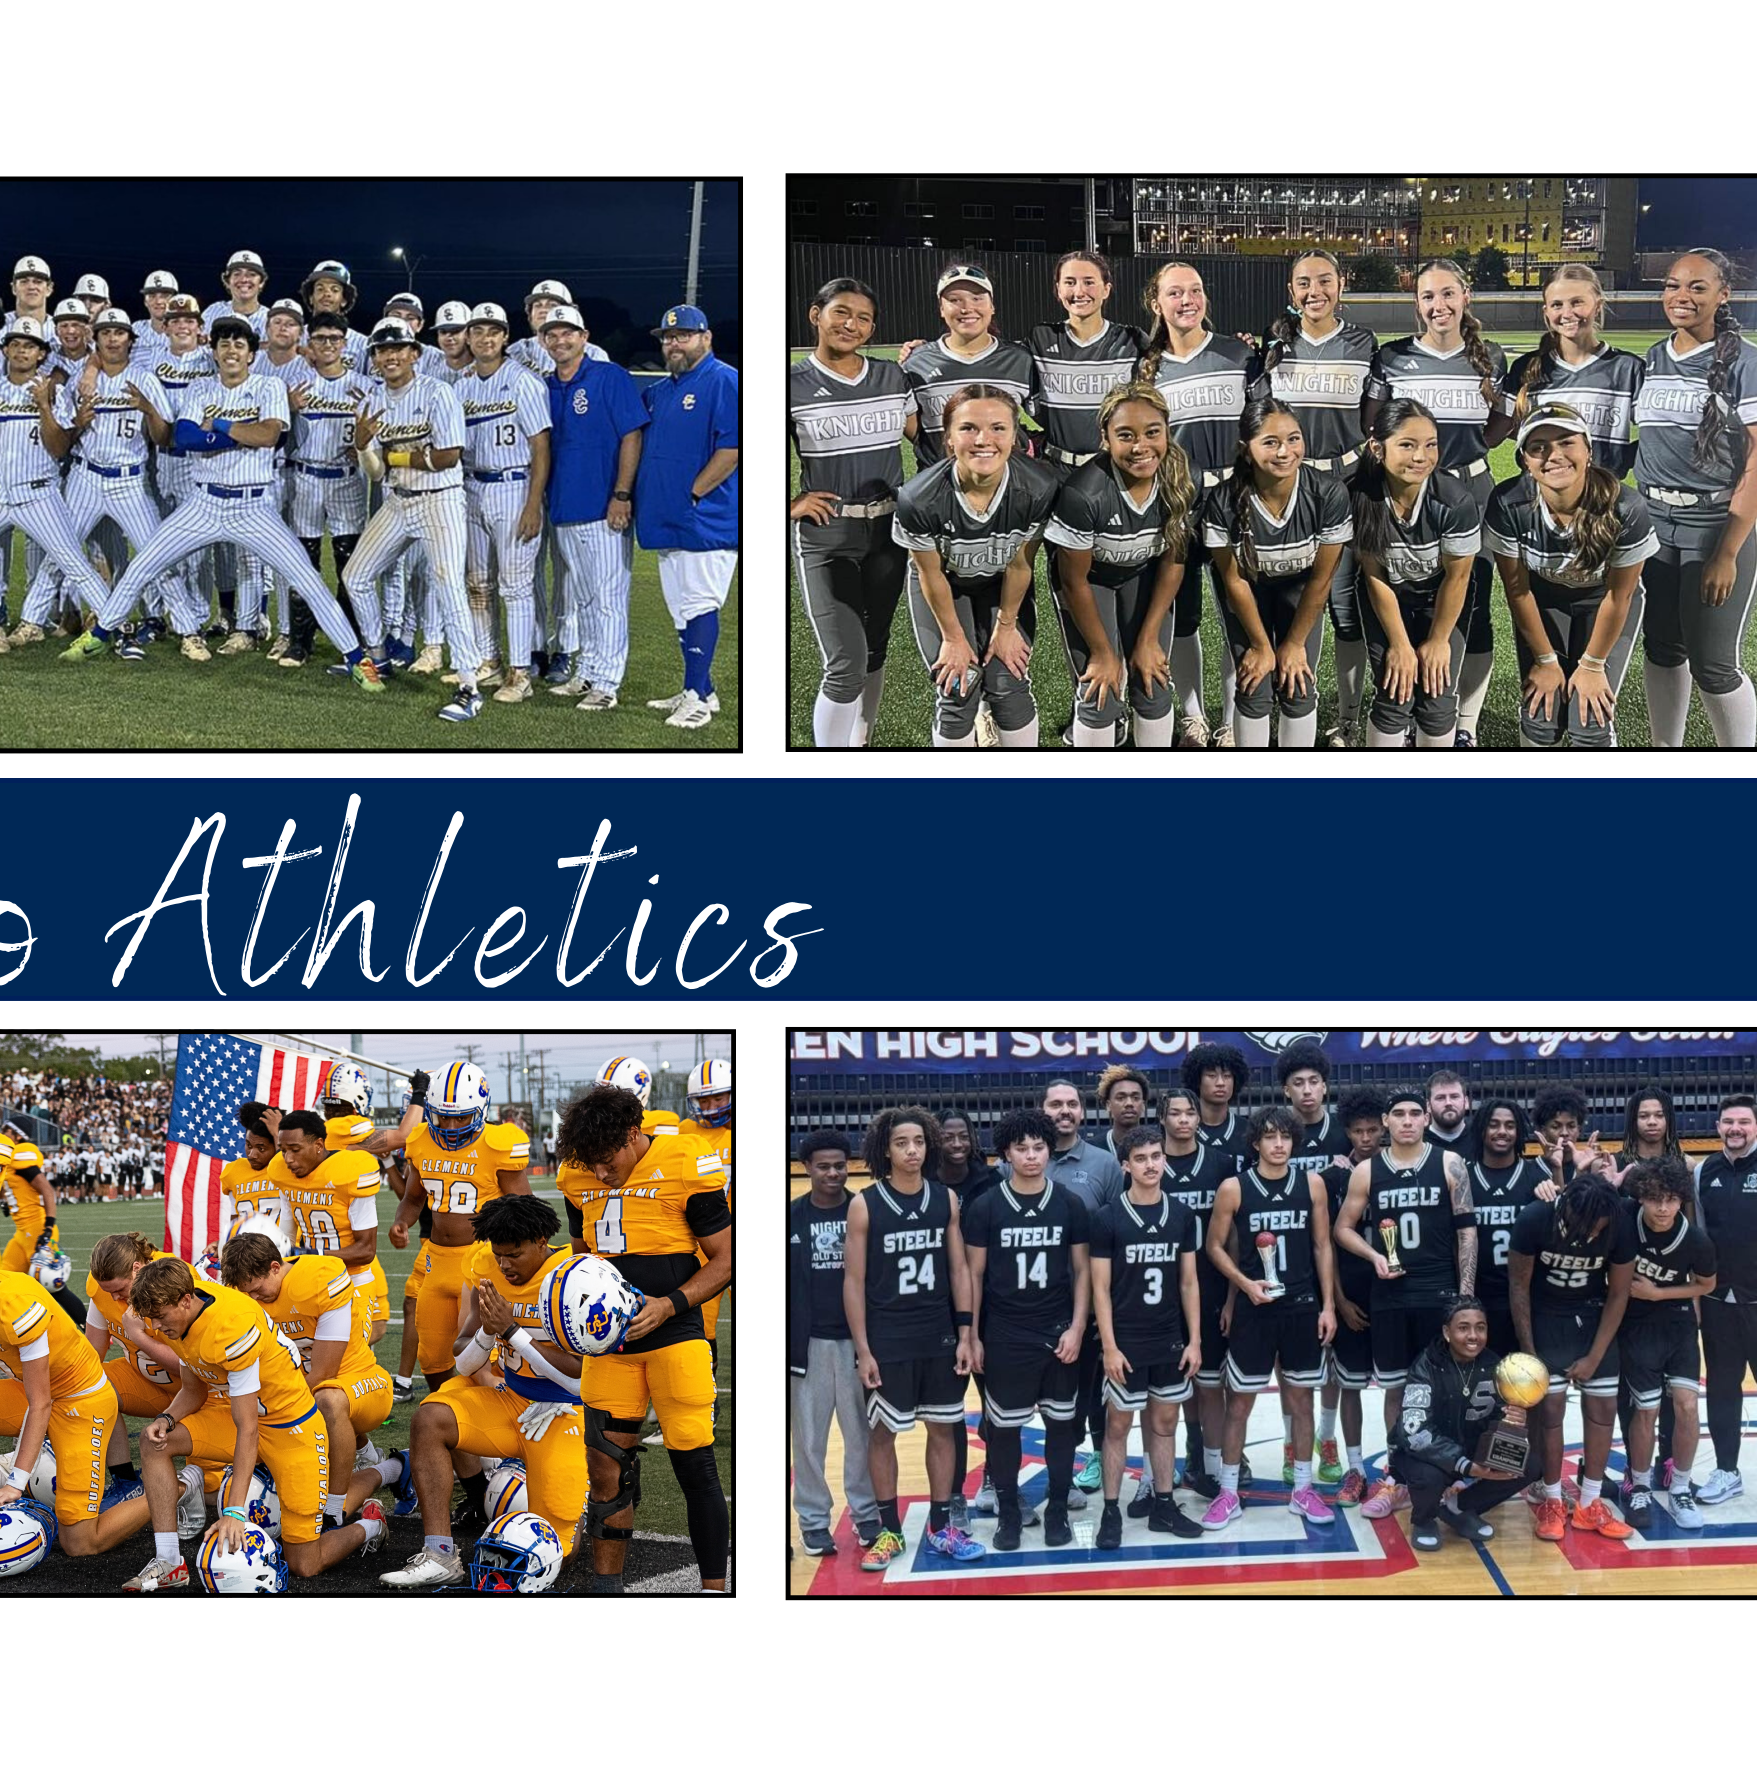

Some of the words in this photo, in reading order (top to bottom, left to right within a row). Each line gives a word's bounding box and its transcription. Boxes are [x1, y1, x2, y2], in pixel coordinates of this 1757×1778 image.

[87, 279, 96, 292] SC
[67, 301, 77, 313] SC
[444, 309, 454, 322] SC
[156, 363, 216, 379] Clemens
[117, 418, 136, 439] 15
[343, 424, 355, 444] 3
[495, 424, 516, 446] 13
[811, 408, 902, 441] KNIGHT
[29, 426, 39, 446] 4
[791, 1032, 863, 1059] EN
[876, 1032, 1001, 1059] HIGH
[421, 1158, 477, 1177] CLEMENS
[236, 1179, 280, 1193] CLEMEN
[284, 1188, 334, 1206] CLEMENS
[420, 1178, 479, 1215] 78
[1378, 1186, 1440, 1211] STEELE
[595, 1196, 627, 1255] 4
[1249, 1210, 1308, 1232] STEELE
[1400, 1212, 1420, 1249] 0
[884, 1227, 944, 1254] STEELE
[1000, 1226, 1063, 1248] STEELE
[1015, 1251, 1048, 1289] 14
[1540, 1250, 1604, 1272] STEELE
[898, 1255, 936, 1296] 24
[1143, 1267, 1163, 1306] 3
[1465, 1380, 1496, 1421] S
[87, 1416, 105, 1513] BUFFALOES
[314, 1431, 326, 1535] BUFFALOES
